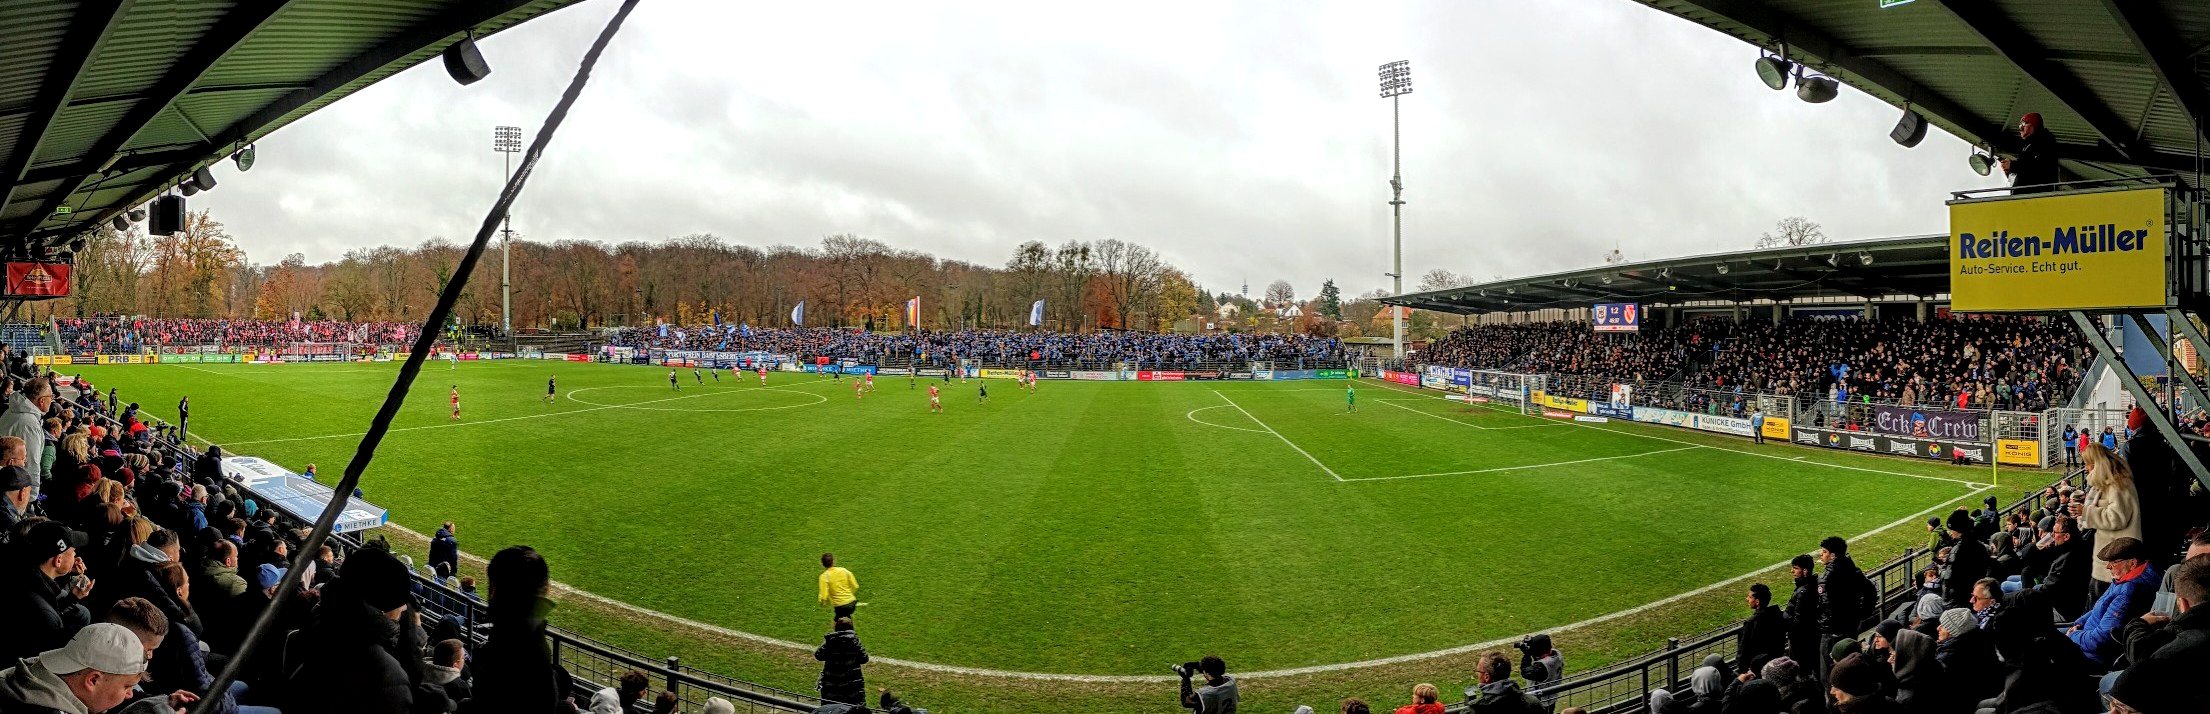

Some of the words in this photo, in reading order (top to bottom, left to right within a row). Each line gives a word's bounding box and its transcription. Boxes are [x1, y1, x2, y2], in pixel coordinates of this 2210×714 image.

[1960, 263, 2028, 276] Auto-Service.
[2032, 262, 2057, 273] Echt
[2060, 261, 2082, 274] gut.
[108, 355, 130, 363] PRB
[1702, 416, 1730, 426] KÜNICKE
[1730, 420, 1751, 430] GmbH
[1877, 411, 1910, 434] Eck
[1928, 416, 1978, 439] Crew
[344, 519, 377, 530] MIETHKE
[56, 538, 68, 552] 3
